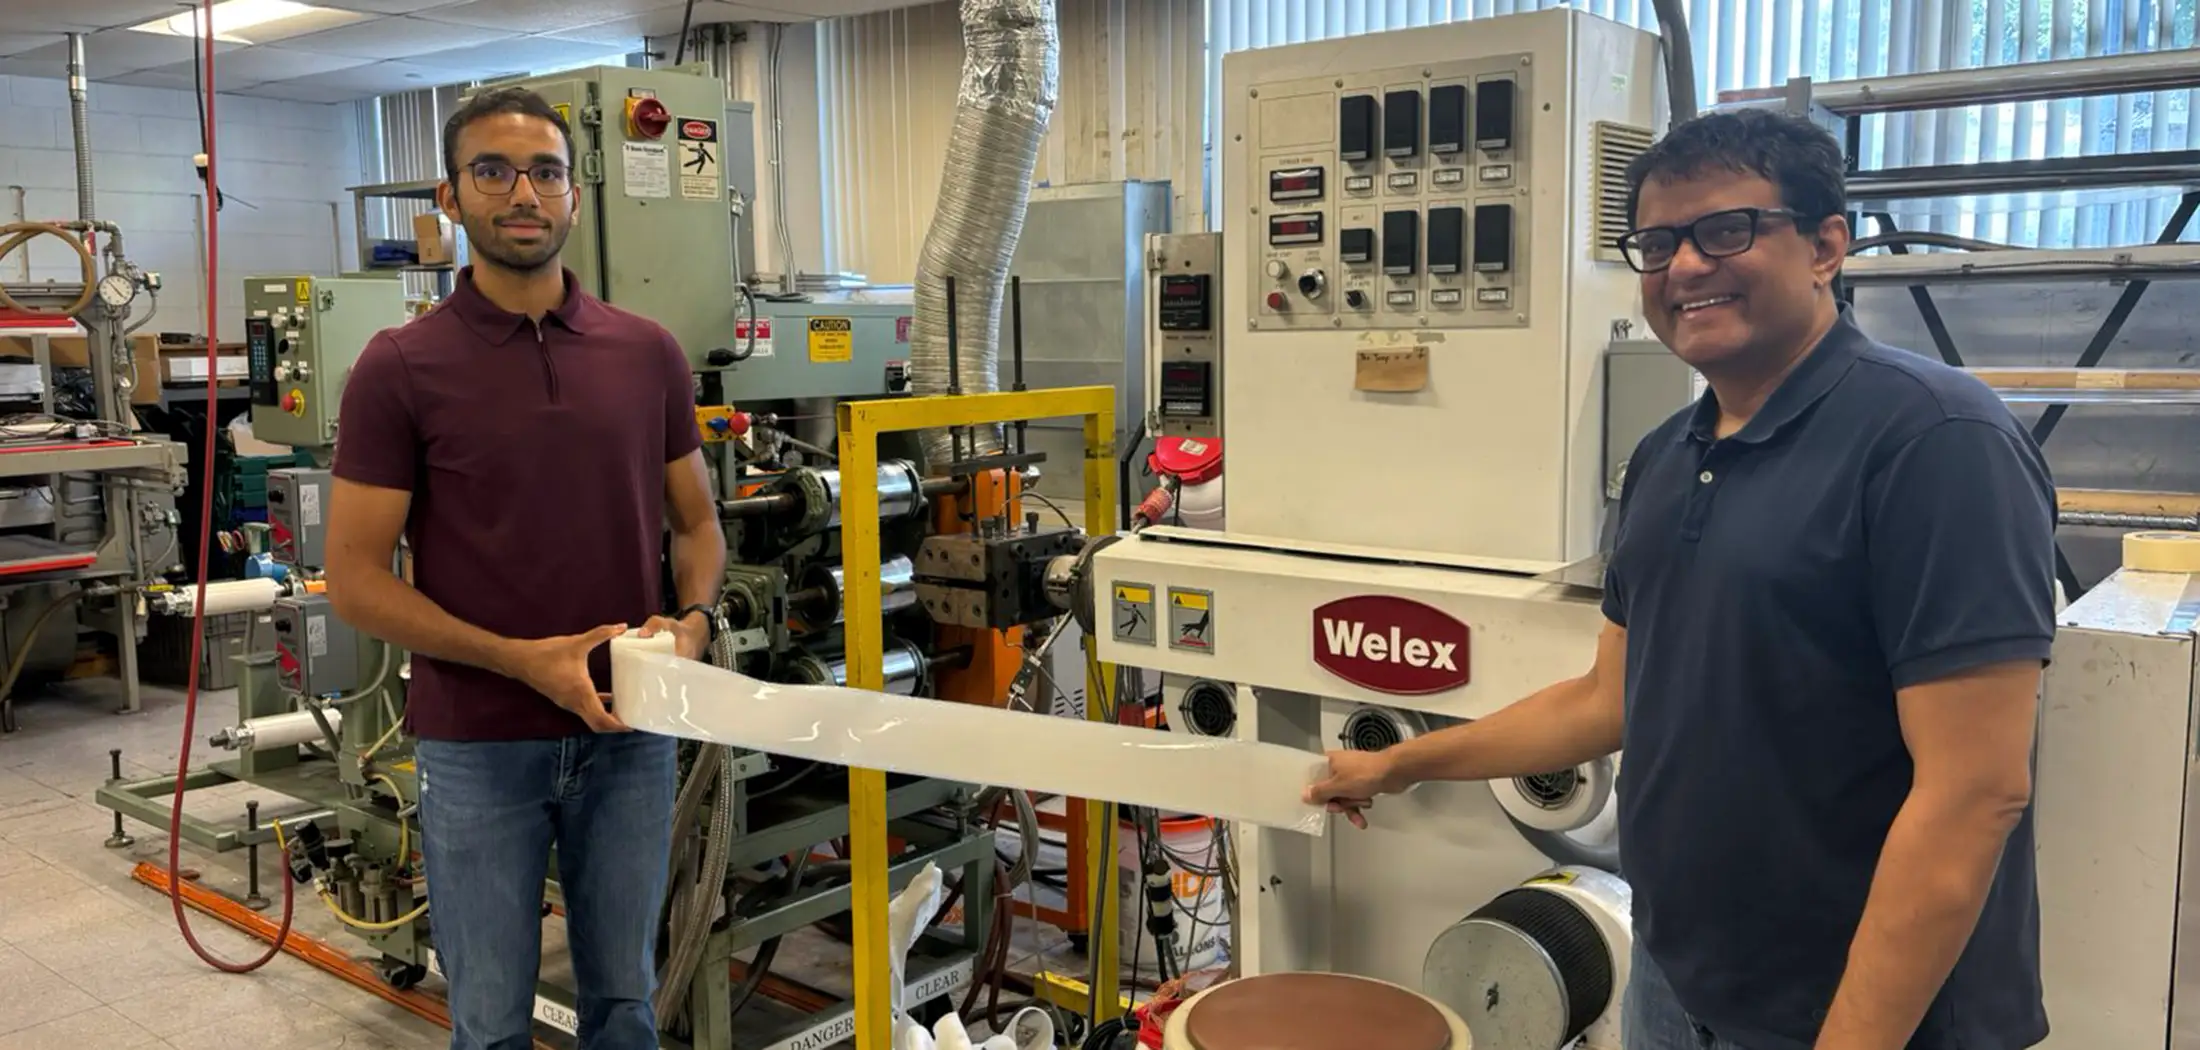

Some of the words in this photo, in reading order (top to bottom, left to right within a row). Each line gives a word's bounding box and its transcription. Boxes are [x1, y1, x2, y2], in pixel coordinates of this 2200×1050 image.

[813, 320, 848, 330] CAUTION
[1322, 618, 1458, 672] Welex
[915, 970, 960, 1000] CLEAR
